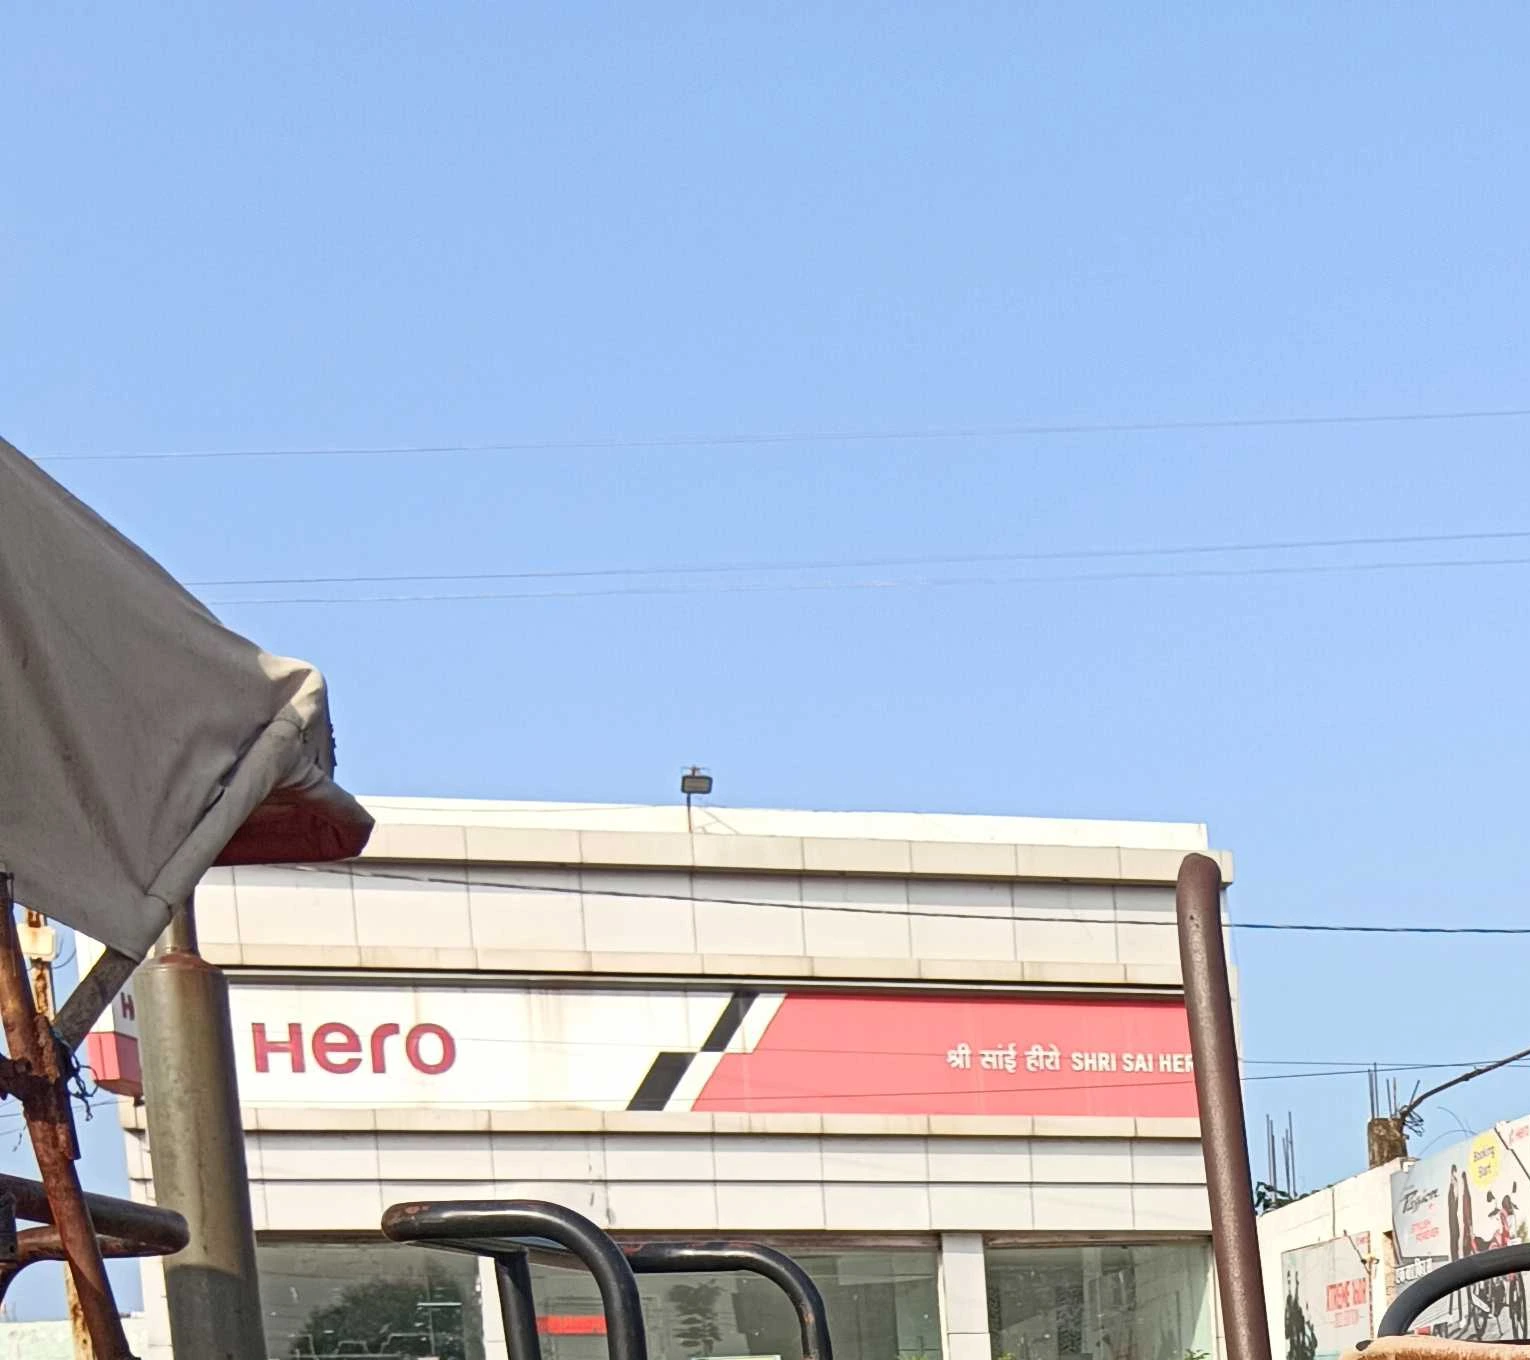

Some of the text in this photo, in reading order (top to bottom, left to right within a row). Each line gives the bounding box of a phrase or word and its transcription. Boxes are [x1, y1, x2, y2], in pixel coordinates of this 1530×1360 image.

[251, 1022, 456, 1075] Hero
[947, 1043, 971, 1070] श्री
[1024, 1044, 1061, 1072] हीरो
[1071, 1052, 1117, 1072] SHRI
[1122, 1053, 1153, 1072] SAI
